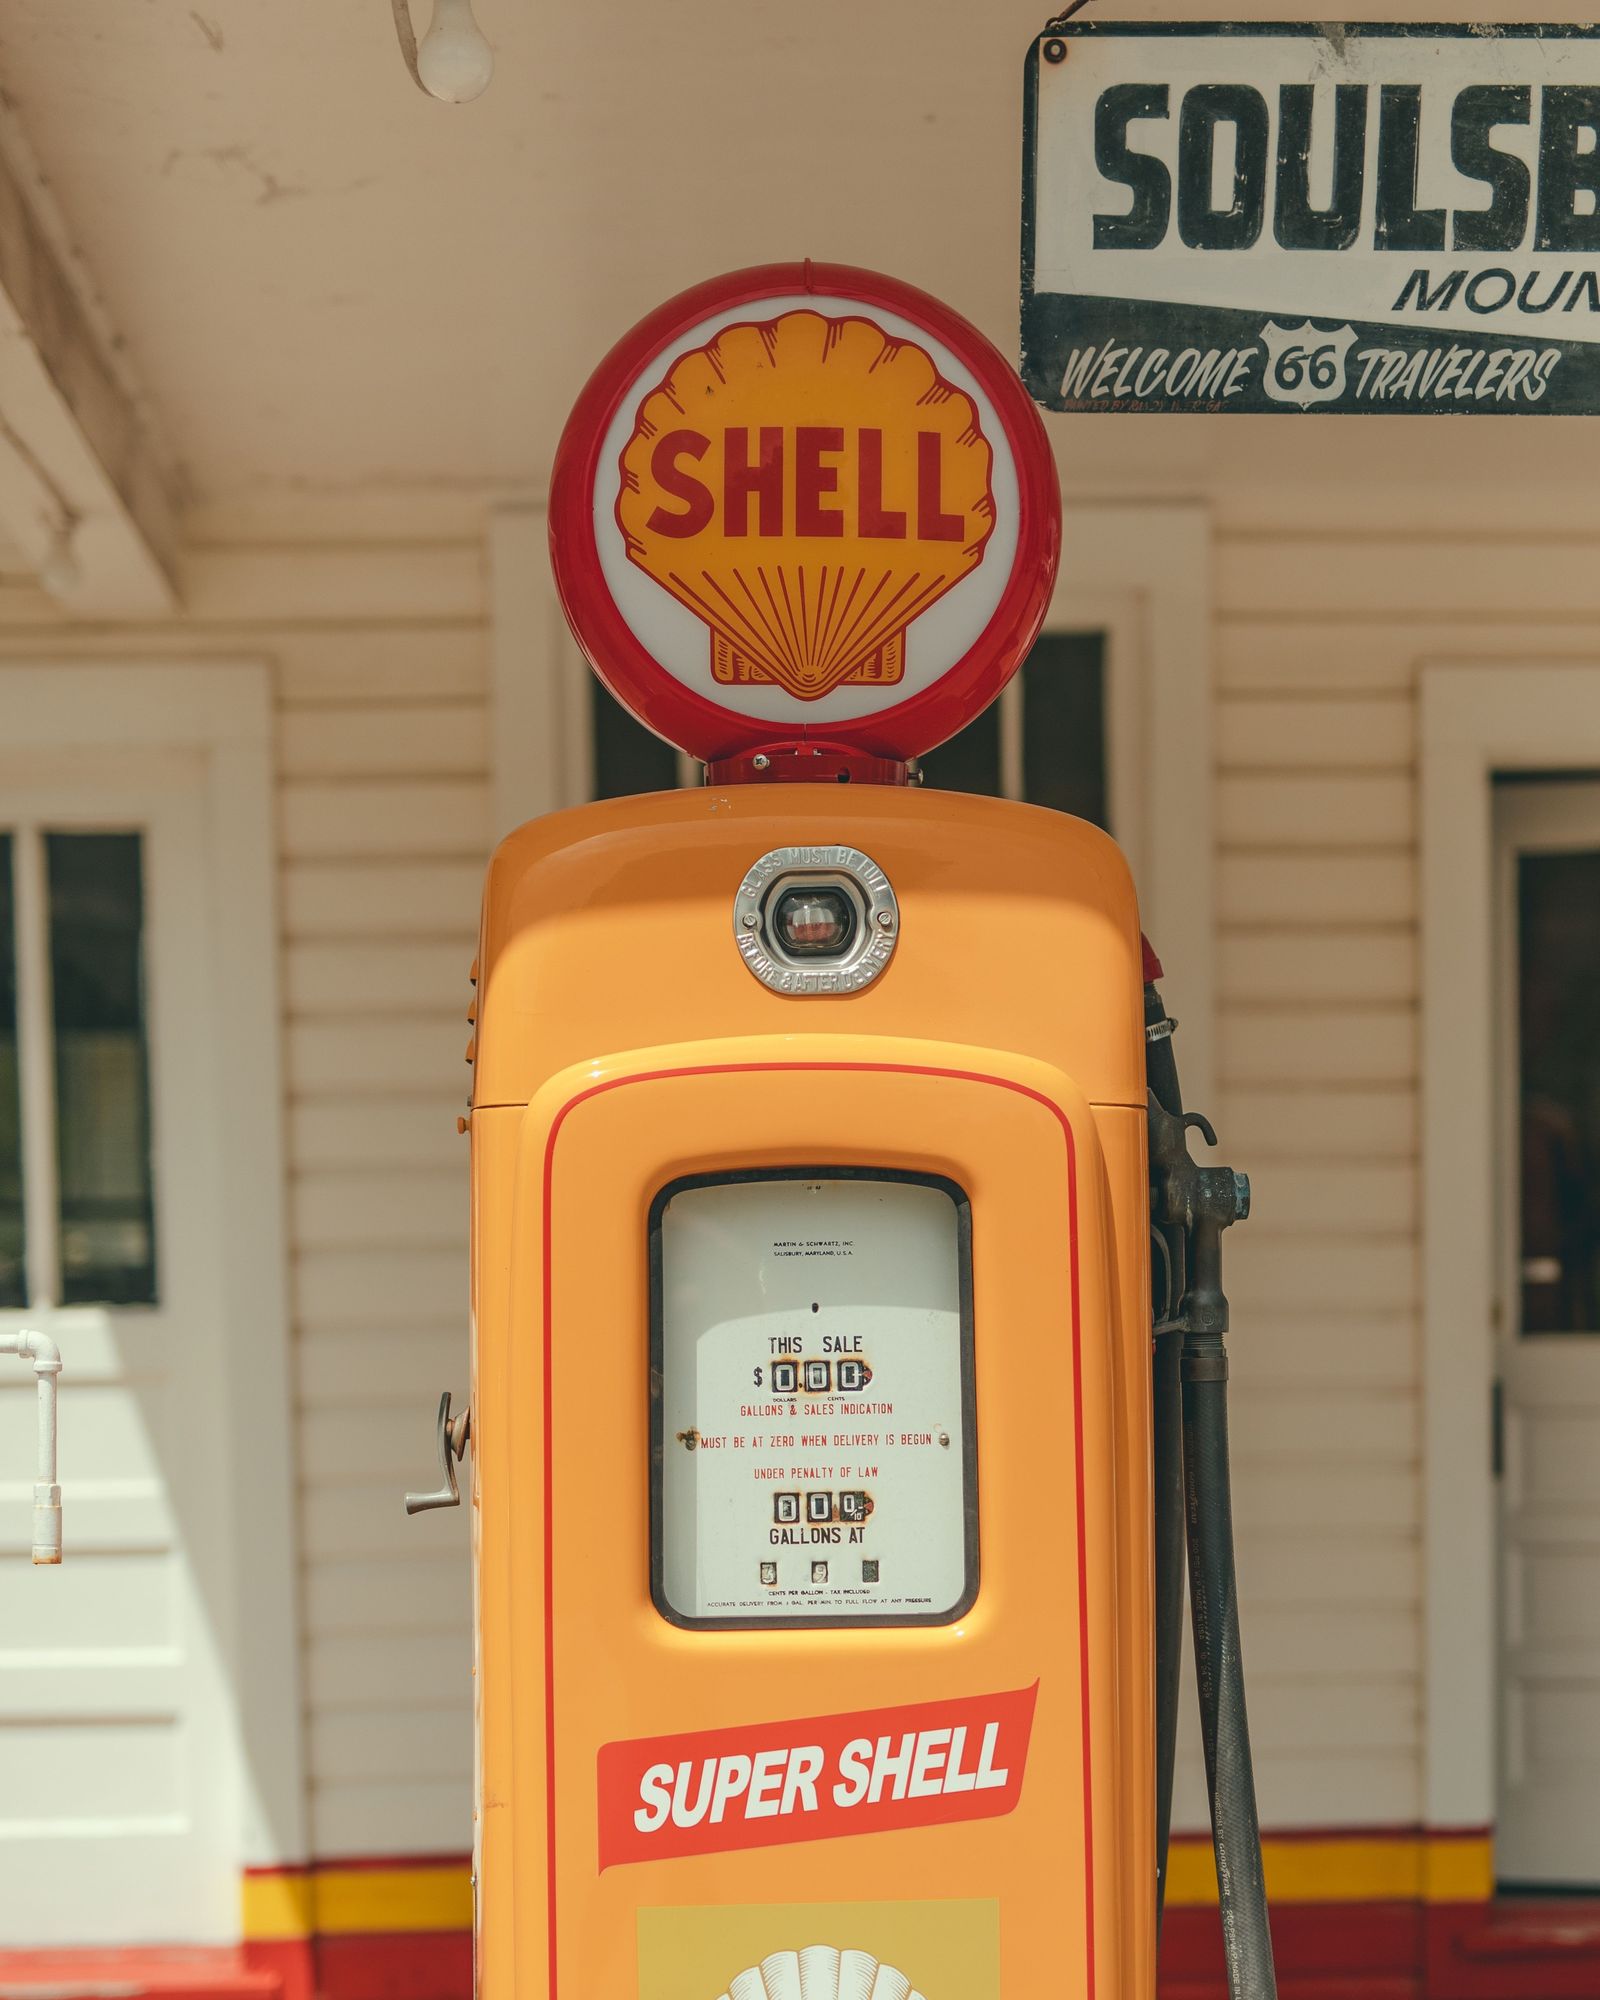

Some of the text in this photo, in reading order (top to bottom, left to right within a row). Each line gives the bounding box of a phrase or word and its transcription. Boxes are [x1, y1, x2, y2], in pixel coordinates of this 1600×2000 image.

[1092, 84, 1600, 252] SOULSB
[1060, 338, 1562, 401] WELCOME 66 TRAVELERS
[645, 427, 965, 542] SHELL
[741, 849, 889, 897] GLASS MUST BE FULL
[737, 932, 778, 985] BEFORE
[794, 972, 840, 992] AFTER
[841, 932, 895, 988] DELIVERY
[769, 1336, 863, 1354] THIS SALE
[741, 1403, 893, 1416] GALLONS & SALES INDICATION
[701, 1434, 932, 1448] MUST BE AT ZERO WHEN DELIVERY IS BEGUN
[754, 1466, 878, 1479] UNDER PENALTY OF LAW
[770, 1527, 865, 1544] GALLONS AT
[633, 1722, 1008, 1833] SUPER SHELL
[1217, 1829, 1224, 1839] BY
[1219, 1843, 1231, 1896] GOODYEAR
[1226, 1910, 1234, 1926] 200
[1232, 1962, 1241, 1984] MADE
[1234, 1986, 1241, 1995] IN
